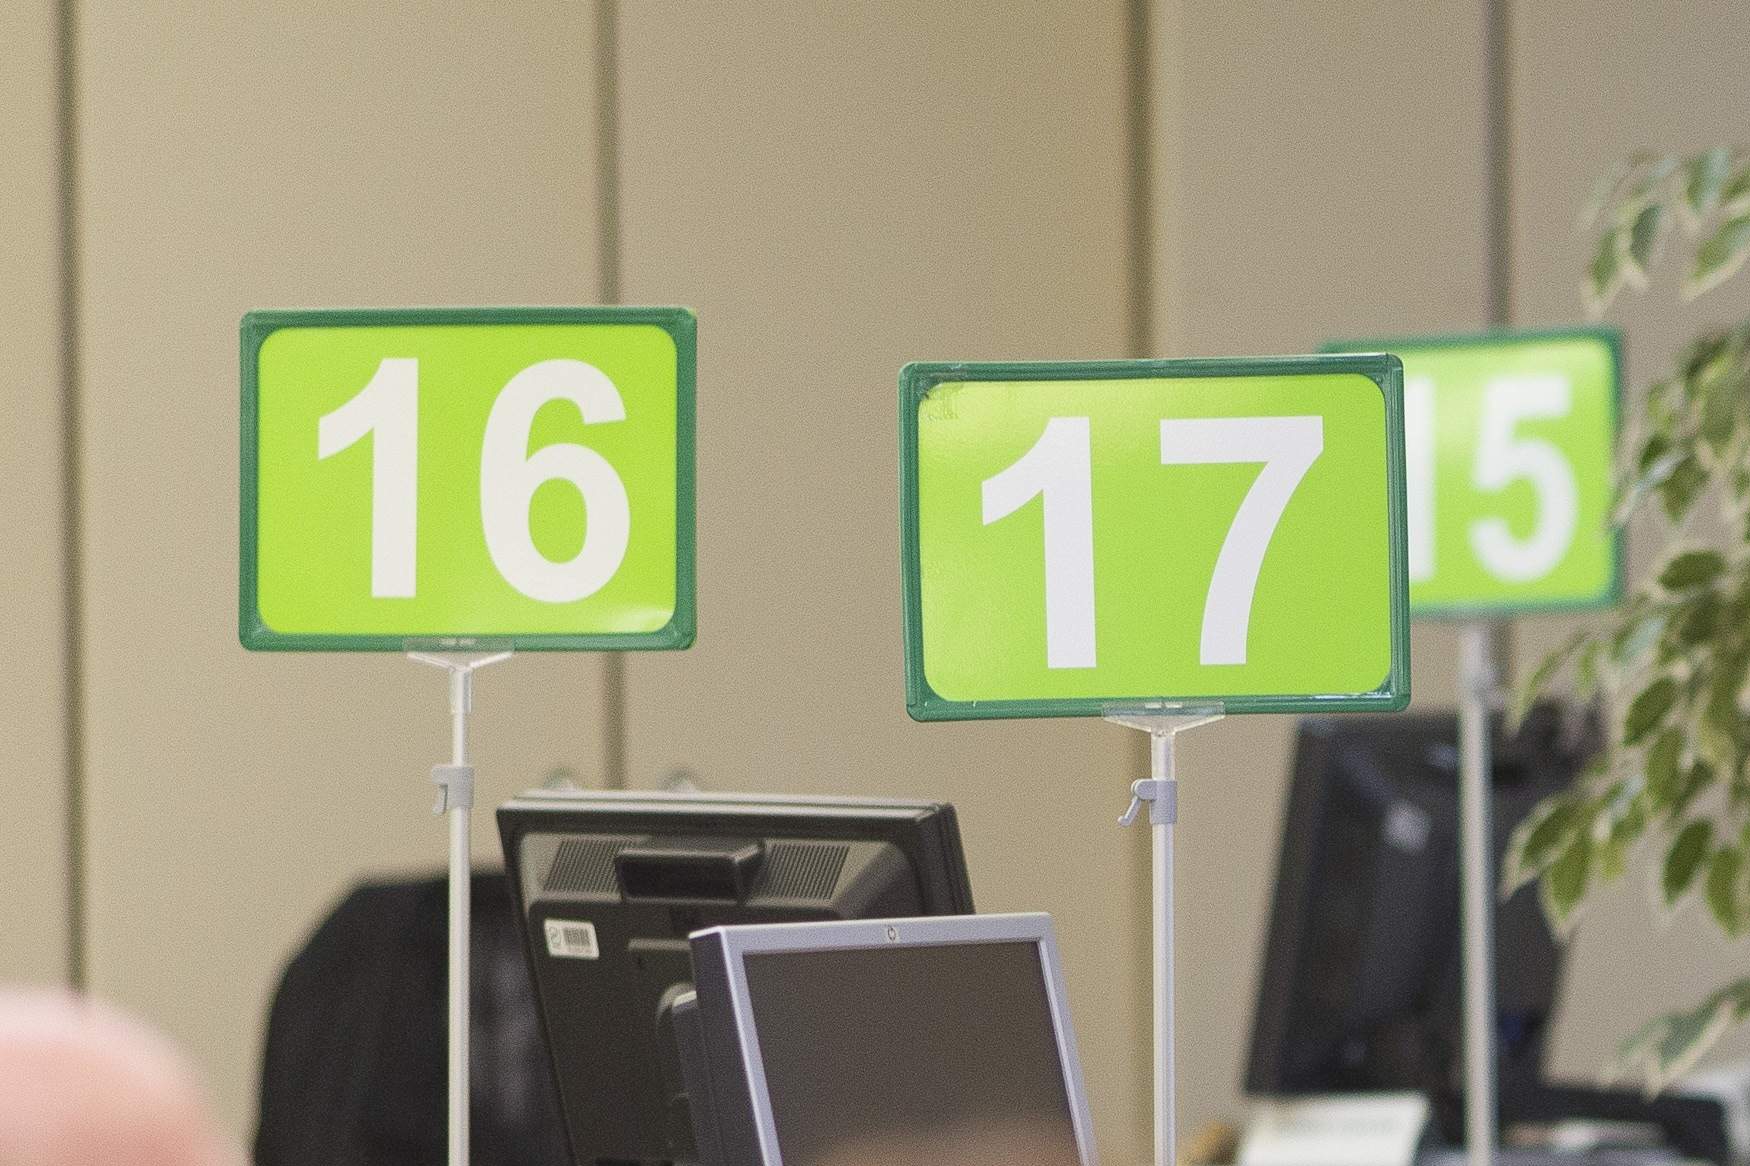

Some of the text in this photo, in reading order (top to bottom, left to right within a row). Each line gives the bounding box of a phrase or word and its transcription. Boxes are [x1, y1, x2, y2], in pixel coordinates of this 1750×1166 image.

[318, 357, 630, 603] 16
[982, 415, 1323, 669] 17
[1404, 376, 1577, 582] 15
